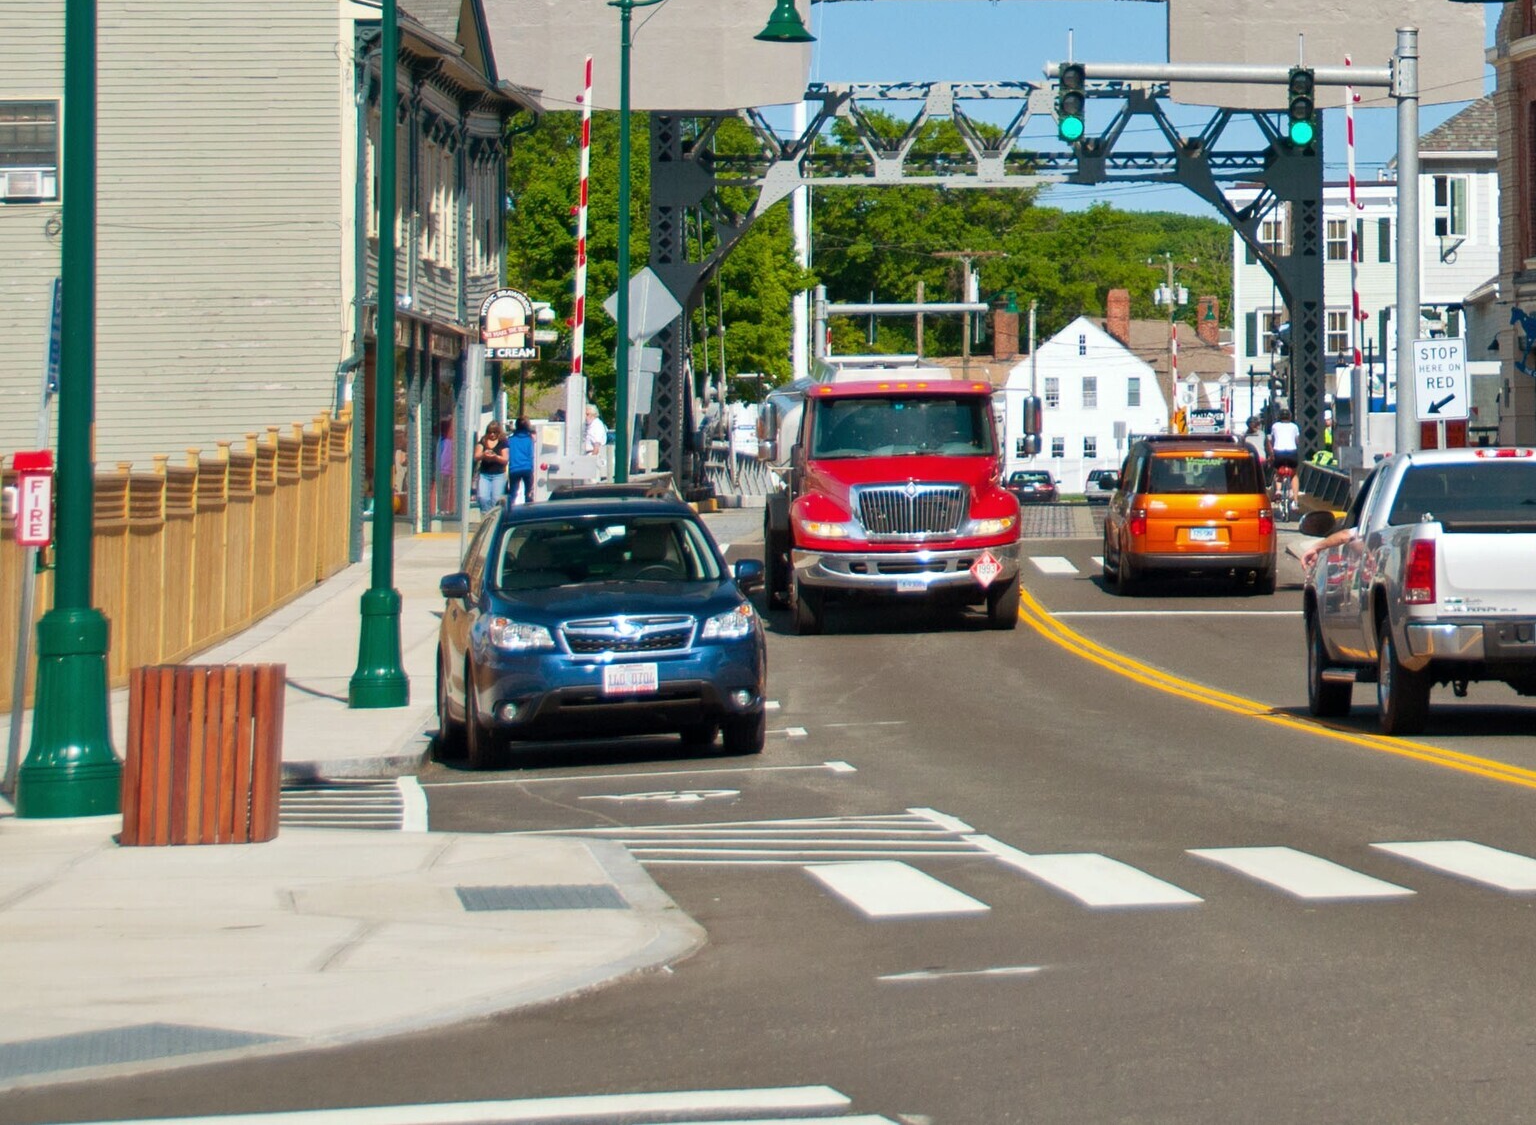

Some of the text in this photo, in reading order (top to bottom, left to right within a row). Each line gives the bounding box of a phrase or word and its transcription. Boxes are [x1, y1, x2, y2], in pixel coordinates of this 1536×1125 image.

[497, 348, 536, 358] CREAM
[1420, 347, 1458, 360] STOP
[1419, 363, 1461, 373] HERE ON
[1426, 376, 1455, 389] RED
[29, 479, 44, 537] FIRE
[980, 564, 996, 575] 1993
